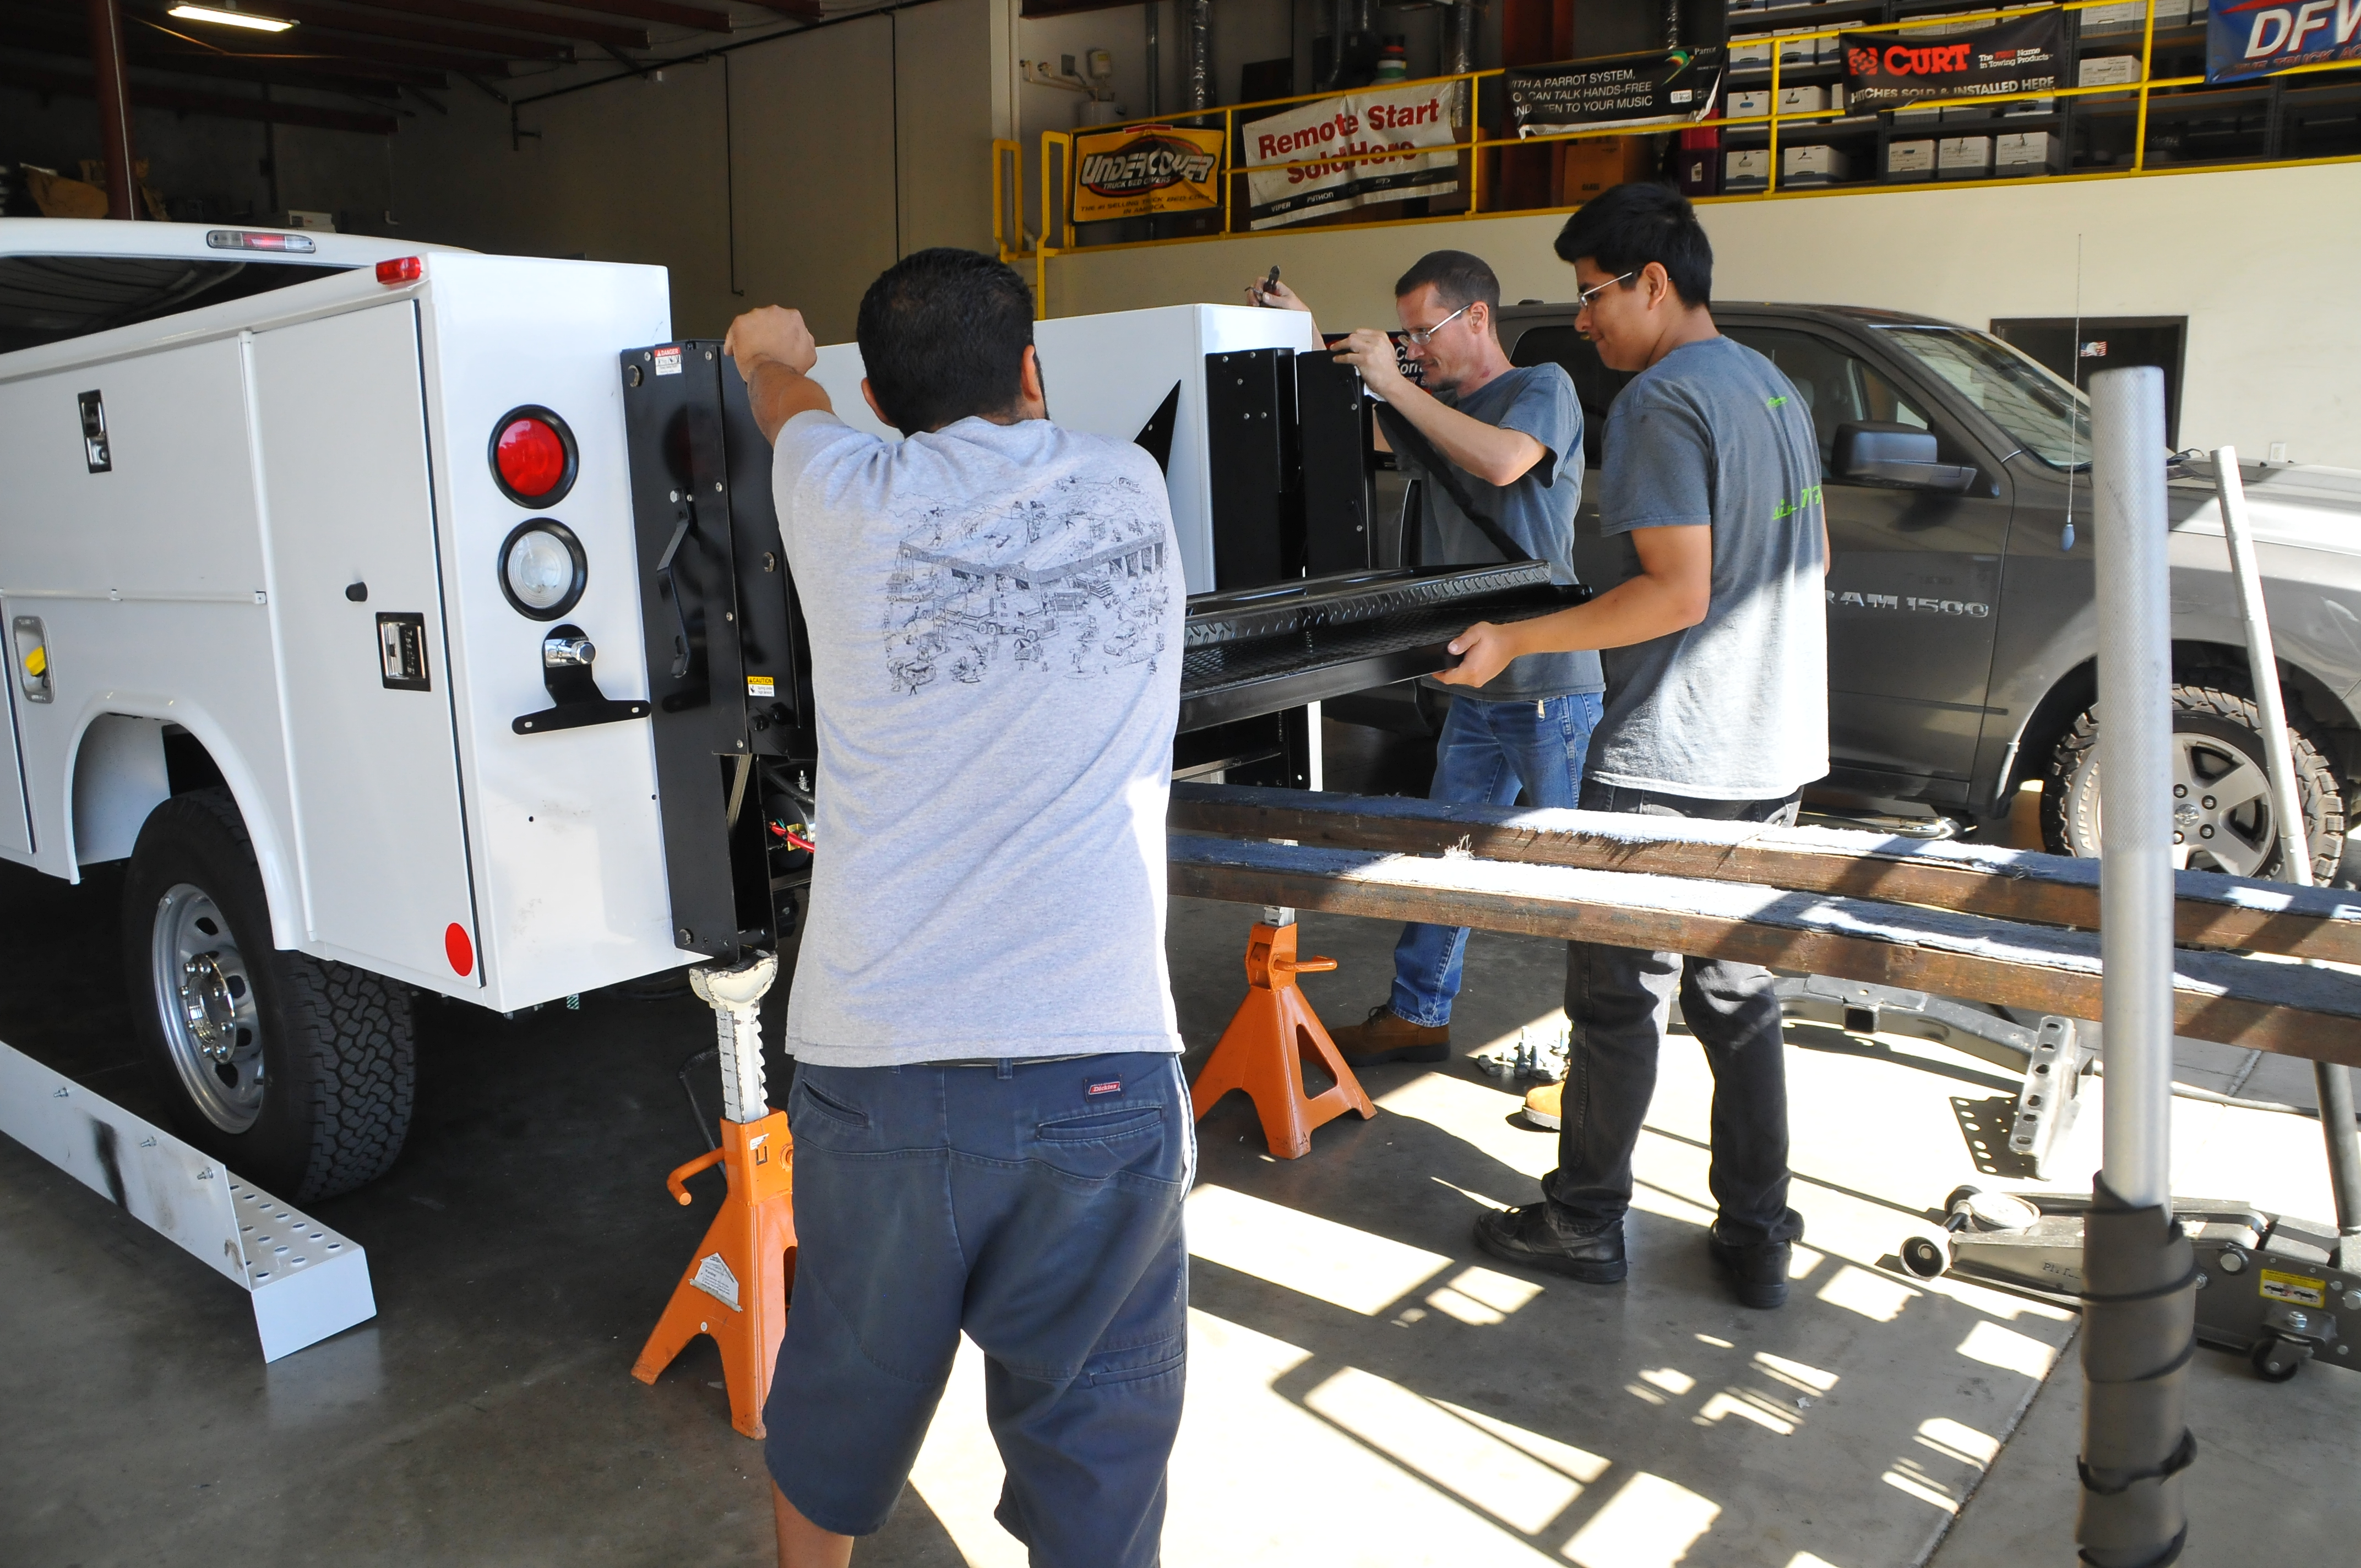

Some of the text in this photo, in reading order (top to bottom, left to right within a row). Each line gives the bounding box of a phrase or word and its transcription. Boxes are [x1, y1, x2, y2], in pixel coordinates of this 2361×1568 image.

[1694, 47, 1716, 55] Parrot
[1883, 43, 1971, 77] CURT
[2017, 47, 2041, 57] Name
[1988, 58, 2016, 68] Towing
[2017, 55, 2050, 64] Products
[1533, 79, 1541, 89] A
[1544, 74, 1587, 88] PARROT
[1590, 69, 1636, 84] SYSTEM,
[1529, 91, 1552, 101] CAN
[1555, 89, 1581, 100] TALK
[1584, 81, 1652, 98] HANDS-FREE
[1851, 88, 1898, 104] HITCHES
[1953, 79, 2019, 97] INSTALLED
[2021, 76, 2055, 92] HERE
[1566, 102, 1581, 113] TO
[1584, 101, 1614, 112] YOUR
[1617, 96, 1653, 110] MUSIC
[1258, 98, 1439, 160] Remote Start
[1103, 182, 1126, 190] TRUCK
[1128, 179, 1143, 187] BED
[1108, 200, 1139, 209] SELLING
[1271, 191, 1334, 213] VIPER PYTHON
[1906, 596, 1989, 618] 1500
[2077, 761, 2099, 851] All-Terr
